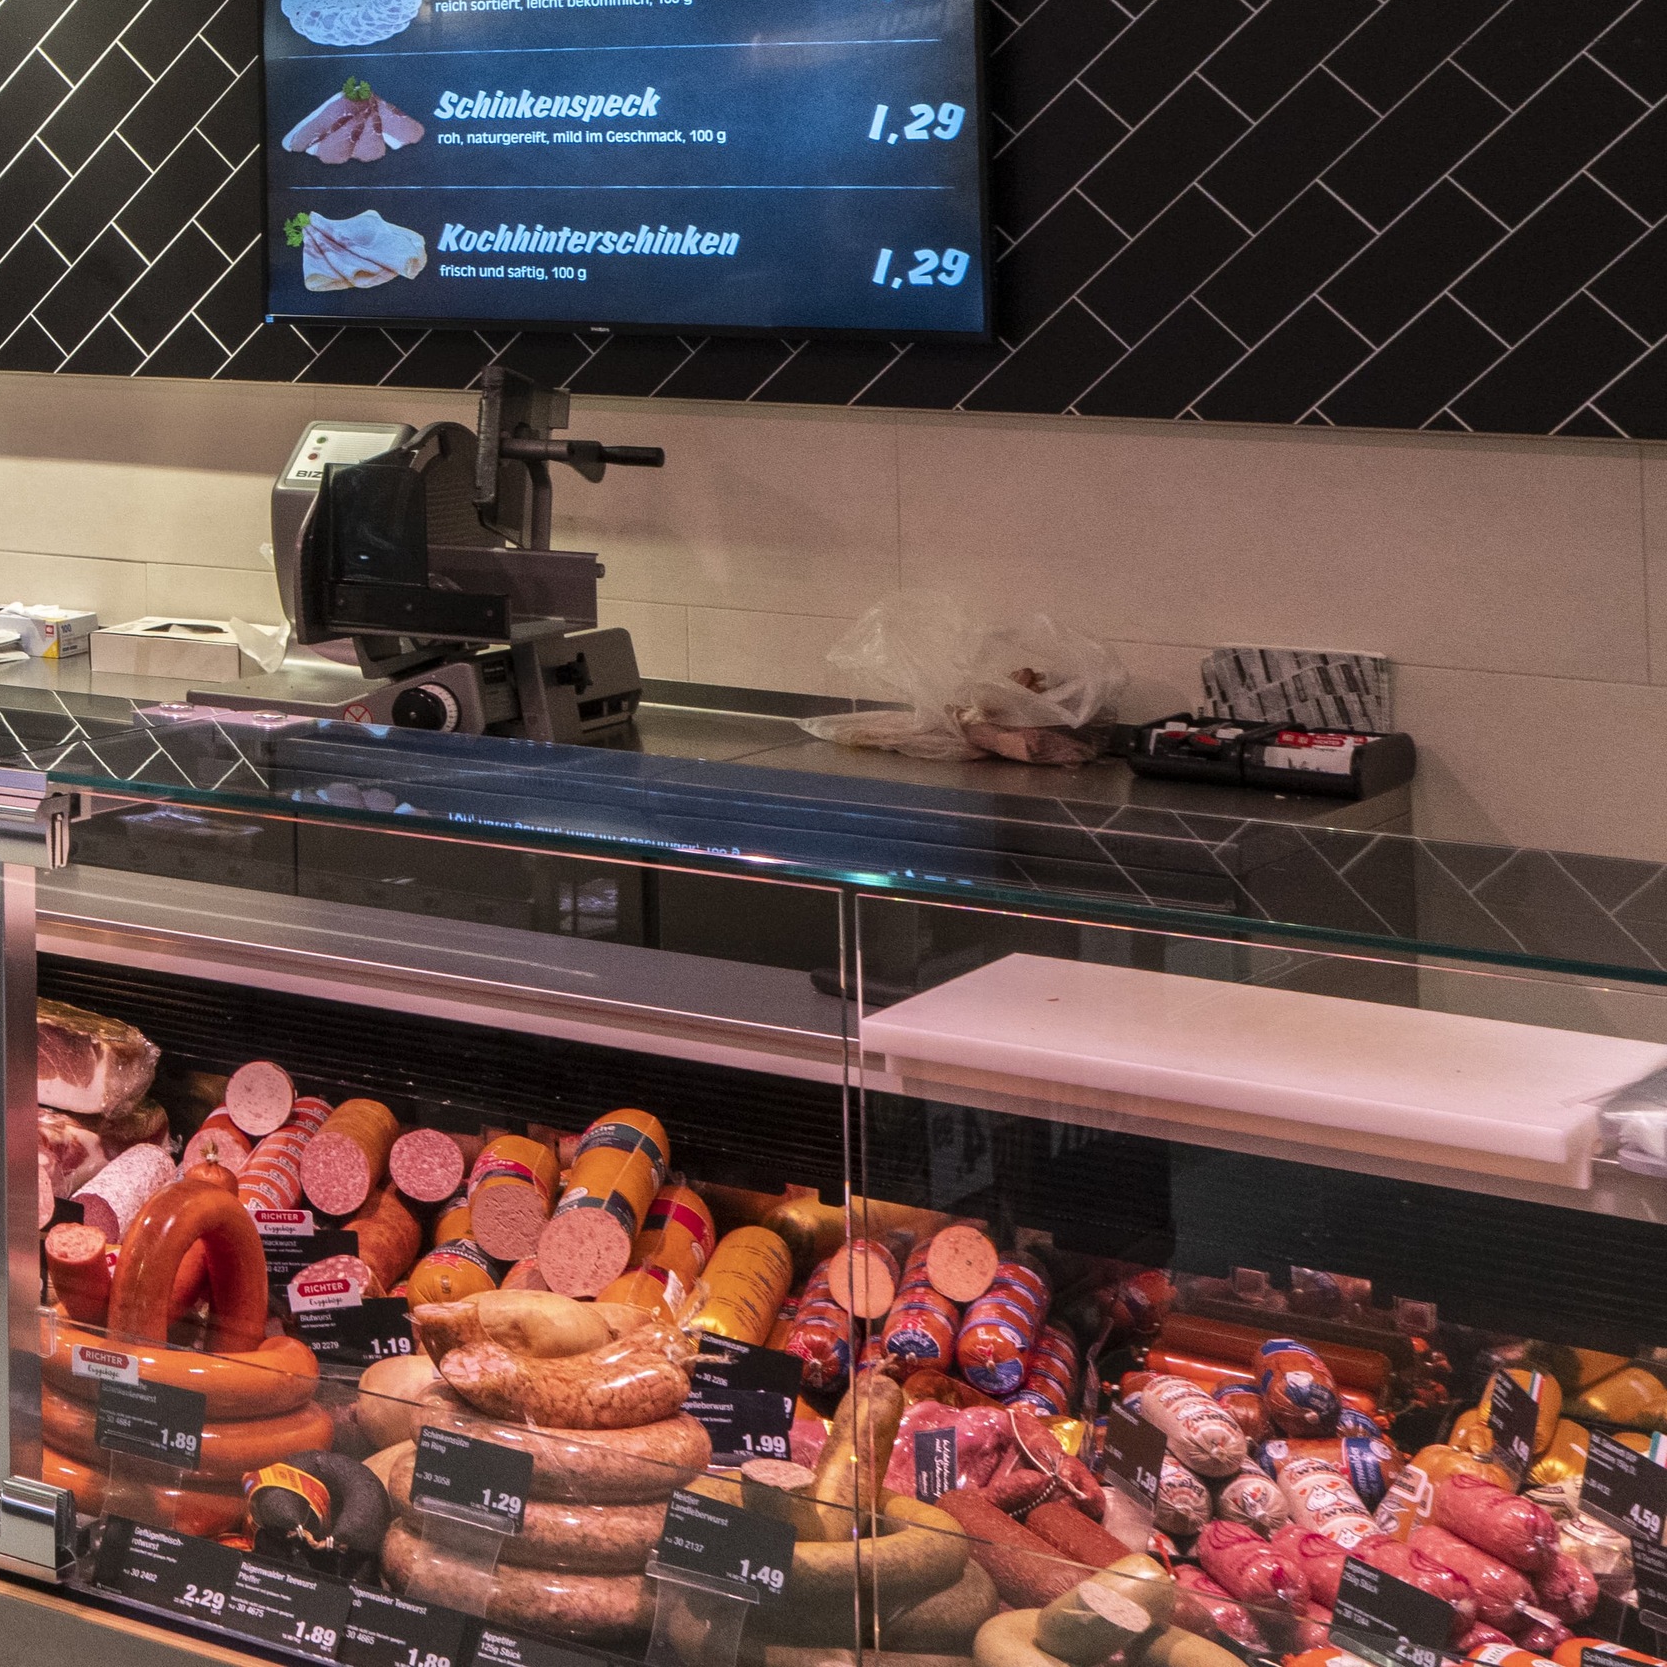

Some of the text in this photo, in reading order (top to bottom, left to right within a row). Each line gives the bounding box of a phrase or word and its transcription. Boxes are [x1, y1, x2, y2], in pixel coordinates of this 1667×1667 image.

[435, 0, 467, 12] reich
[433, 88, 661, 122] Schinkenspeck
[868, 101, 965, 146] 1,29
[438, 130, 713, 146] roh, naturgereift, mild im Geschmack, 100
[438, 223, 740, 257] Kochhinterschinken
[440, 264, 587, 281] frisch und saftig, 100 g
[872, 247, 971, 289] 1,29
[261, 1212, 299, 1221] RICHTER
[304, 1282, 344, 1294] RICHTER
[300, 1314, 332, 1322] Blutwurst
[322, 1341, 339, 1350] 2279
[371, 1337, 411, 1355] 1.19
[85, 1350, 123, 1365] RICHTER
[161, 1428, 197, 1452] 1.89
[421, 1440, 446, 1454] im Ring
[422, 1429, 470, 1448] Schinkensülze
[742, 1433, 787, 1454] 1.99
[1136, 1465, 1159, 1492] 1.39
[482, 1489, 521, 1514] 1.29
[670, 1501, 729, 1527] Landleberwurst
[1629, 1502, 1661, 1532] 4.59
[131, 1537, 159, 1551] rotwurst
[134, 1526, 183, 1547] Geflügelfleisch-
[684, 1539, 705, 1553] 2137
[238, 1571, 261, 1585] Pfeffer
[241, 1561, 317, 1591] Rügenwalder Teewurst
[739, 1558, 785, 1589] 1.49
[183, 1584, 225, 1610] 2.29
[395, 1598, 427, 1615] Teewurst
[295, 1620, 337, 1647] 1.89
[483, 1632, 517, 1647] Appetiter
[481, 1642, 522, 1660] 125g Stück
